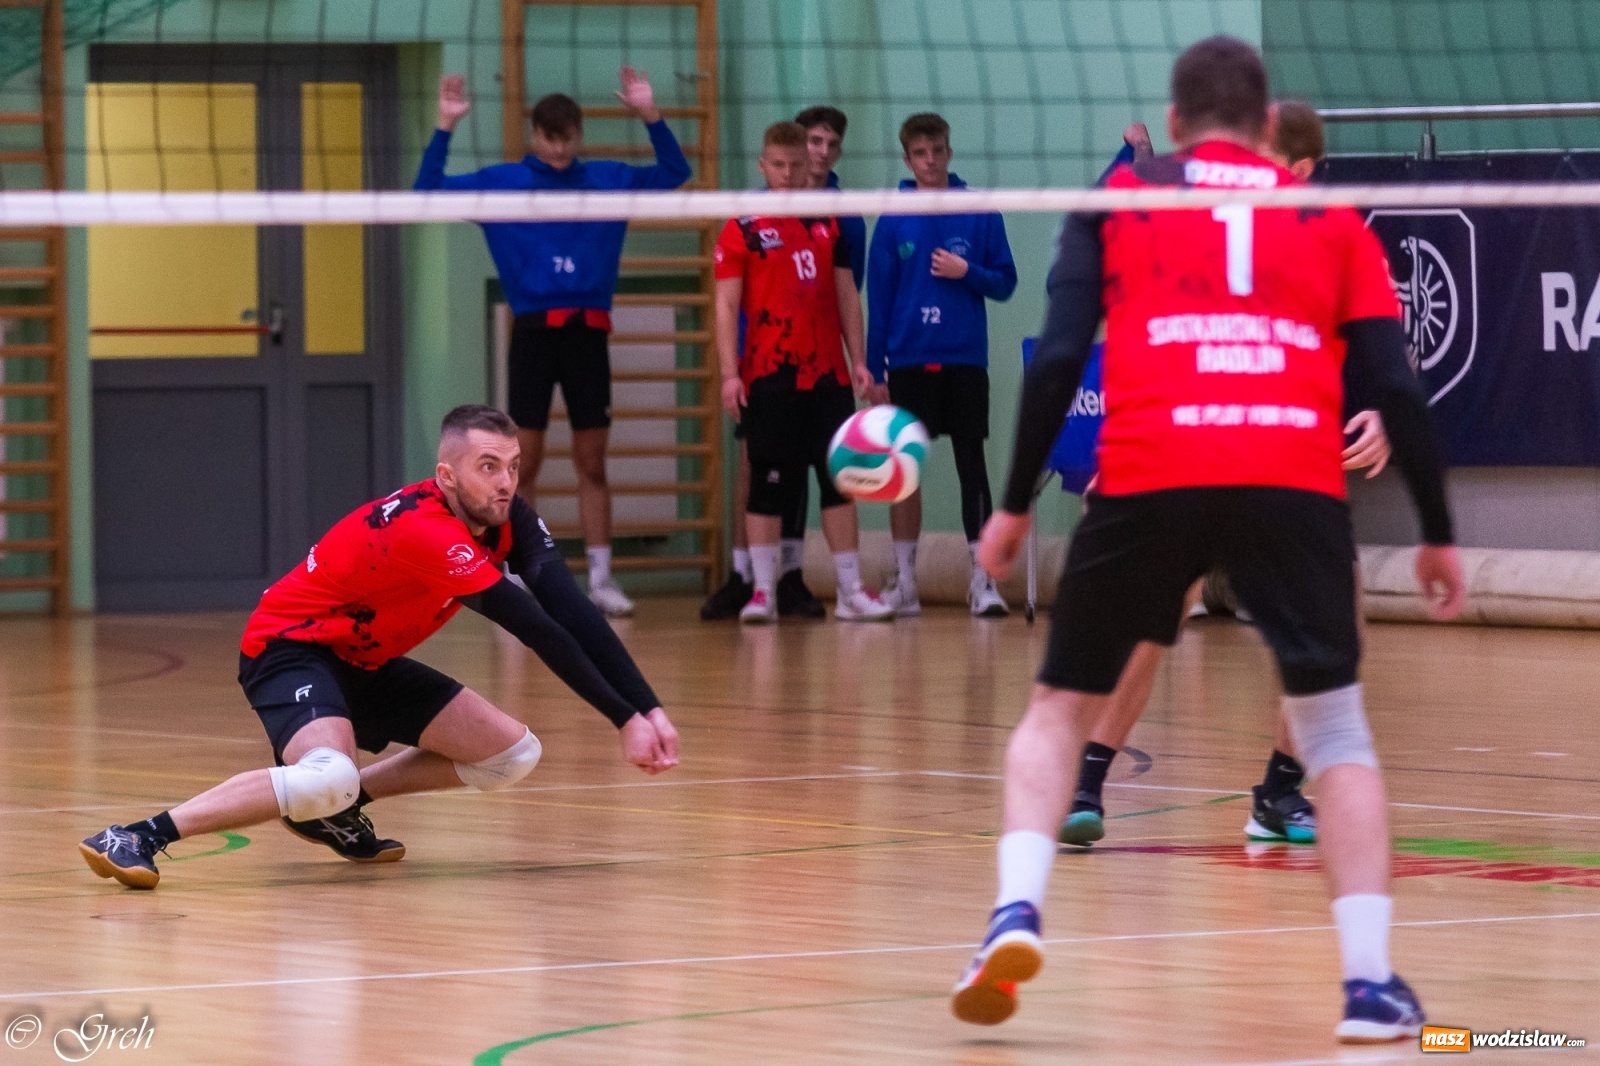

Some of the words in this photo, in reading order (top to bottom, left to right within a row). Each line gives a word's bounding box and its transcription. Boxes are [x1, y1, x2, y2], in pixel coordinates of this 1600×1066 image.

[552, 256, 575, 274] 76
[791, 249, 817, 280] 13
[920, 306, 941, 324] 72
